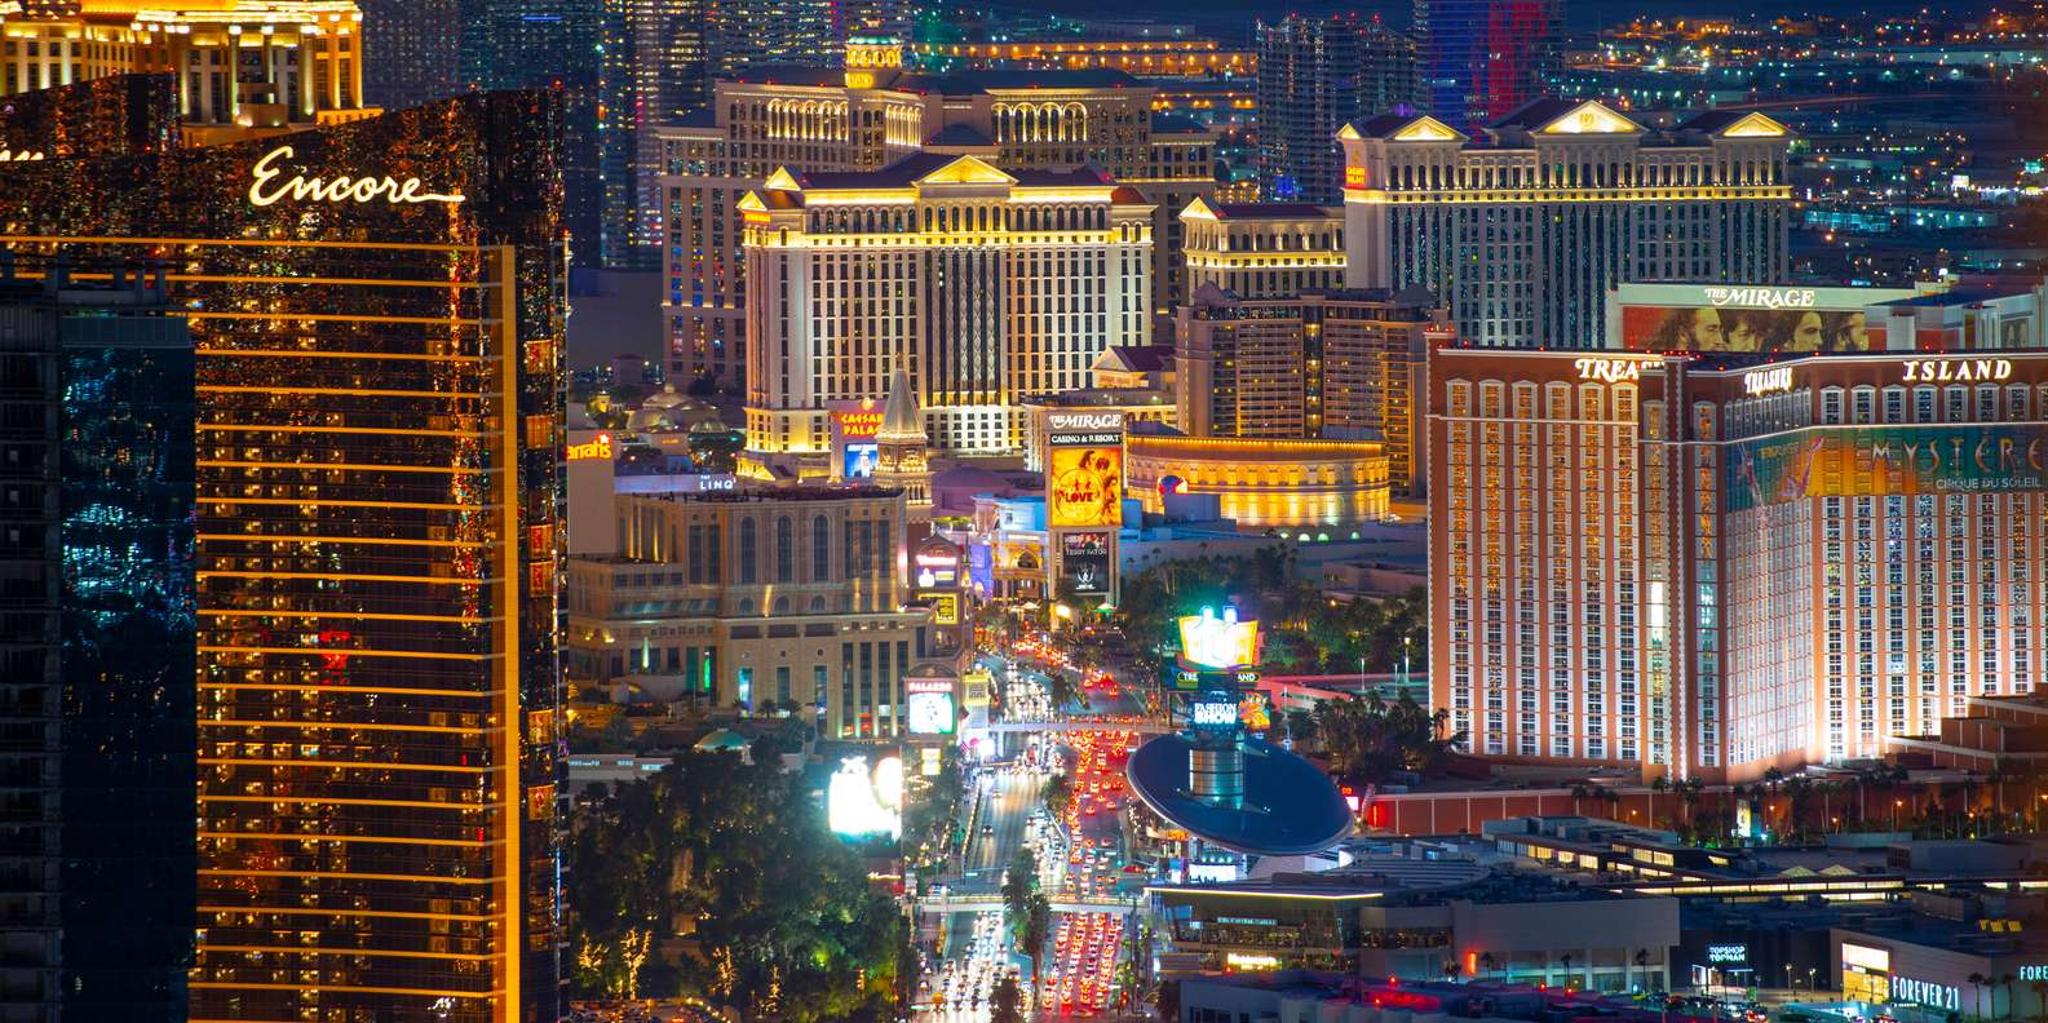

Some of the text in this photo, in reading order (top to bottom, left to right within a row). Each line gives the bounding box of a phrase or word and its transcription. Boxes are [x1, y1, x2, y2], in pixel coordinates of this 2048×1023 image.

[250, 145, 465, 206] Encore
[1704, 287, 1815, 309] THE MIRAGE
[1902, 359, 2012, 381] ISLAND
[1053, 414, 1121, 429] MIRAGE
[1051, 434, 1080, 443] CASINO
[1088, 434, 1120, 443] RESORT
[700, 480, 733, 490] LINQ
[1935, 477, 2042, 490] CIRQUE DU SOLEIL
[1065, 492, 1093, 502] LOVE
[1194, 703, 1237, 712] FASHION
[1893, 975, 1960, 1011] FOREVER 21
